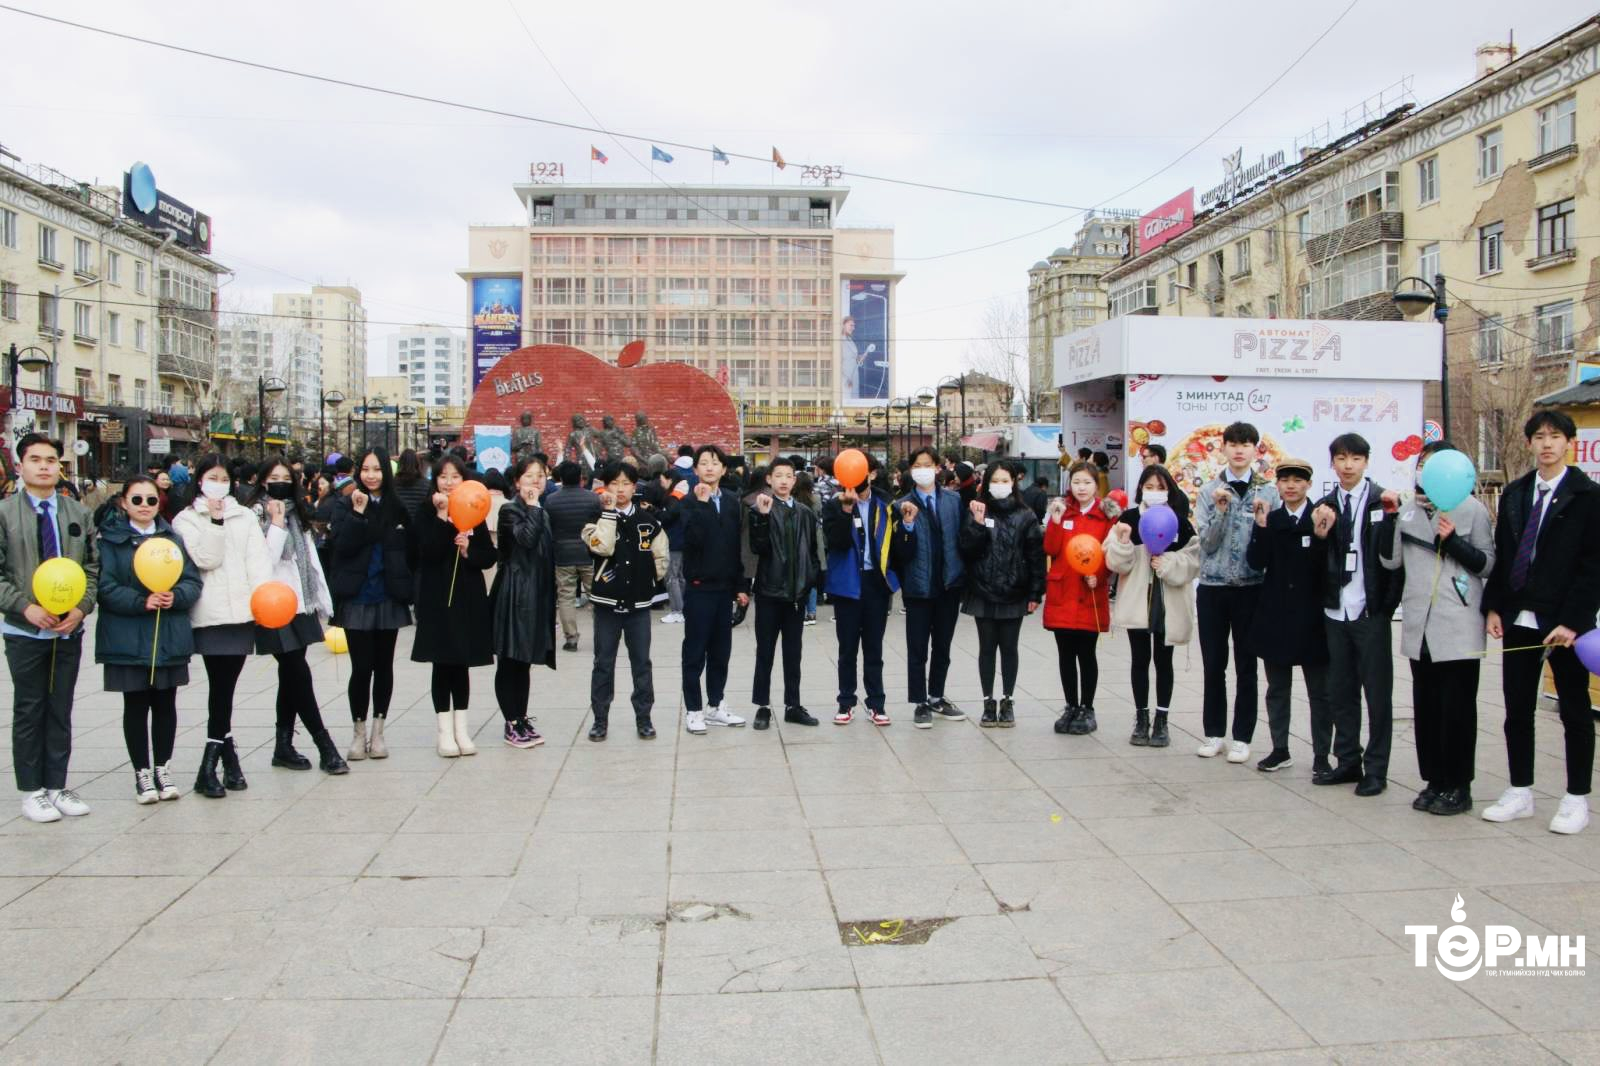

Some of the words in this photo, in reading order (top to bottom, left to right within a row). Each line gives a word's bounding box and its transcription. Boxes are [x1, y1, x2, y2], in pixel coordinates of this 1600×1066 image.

[530, 162, 564, 177] 1921
[801, 165, 842, 179] 2023
[159, 200, 193, 227] monpay
[1234, 330, 1341, 361] PIZZA
[493, 372, 543, 397] BEATLES
[1177, 392, 1183, 400] 3
[1187, 392, 1245, 401] МИНУТАД
[1252, 395, 1271, 404] 24/7
[1074, 400, 1118, 413] PIZZA
[1313, 398, 1399, 422] PIZZA
[1109, 455, 1119, 470] 2
